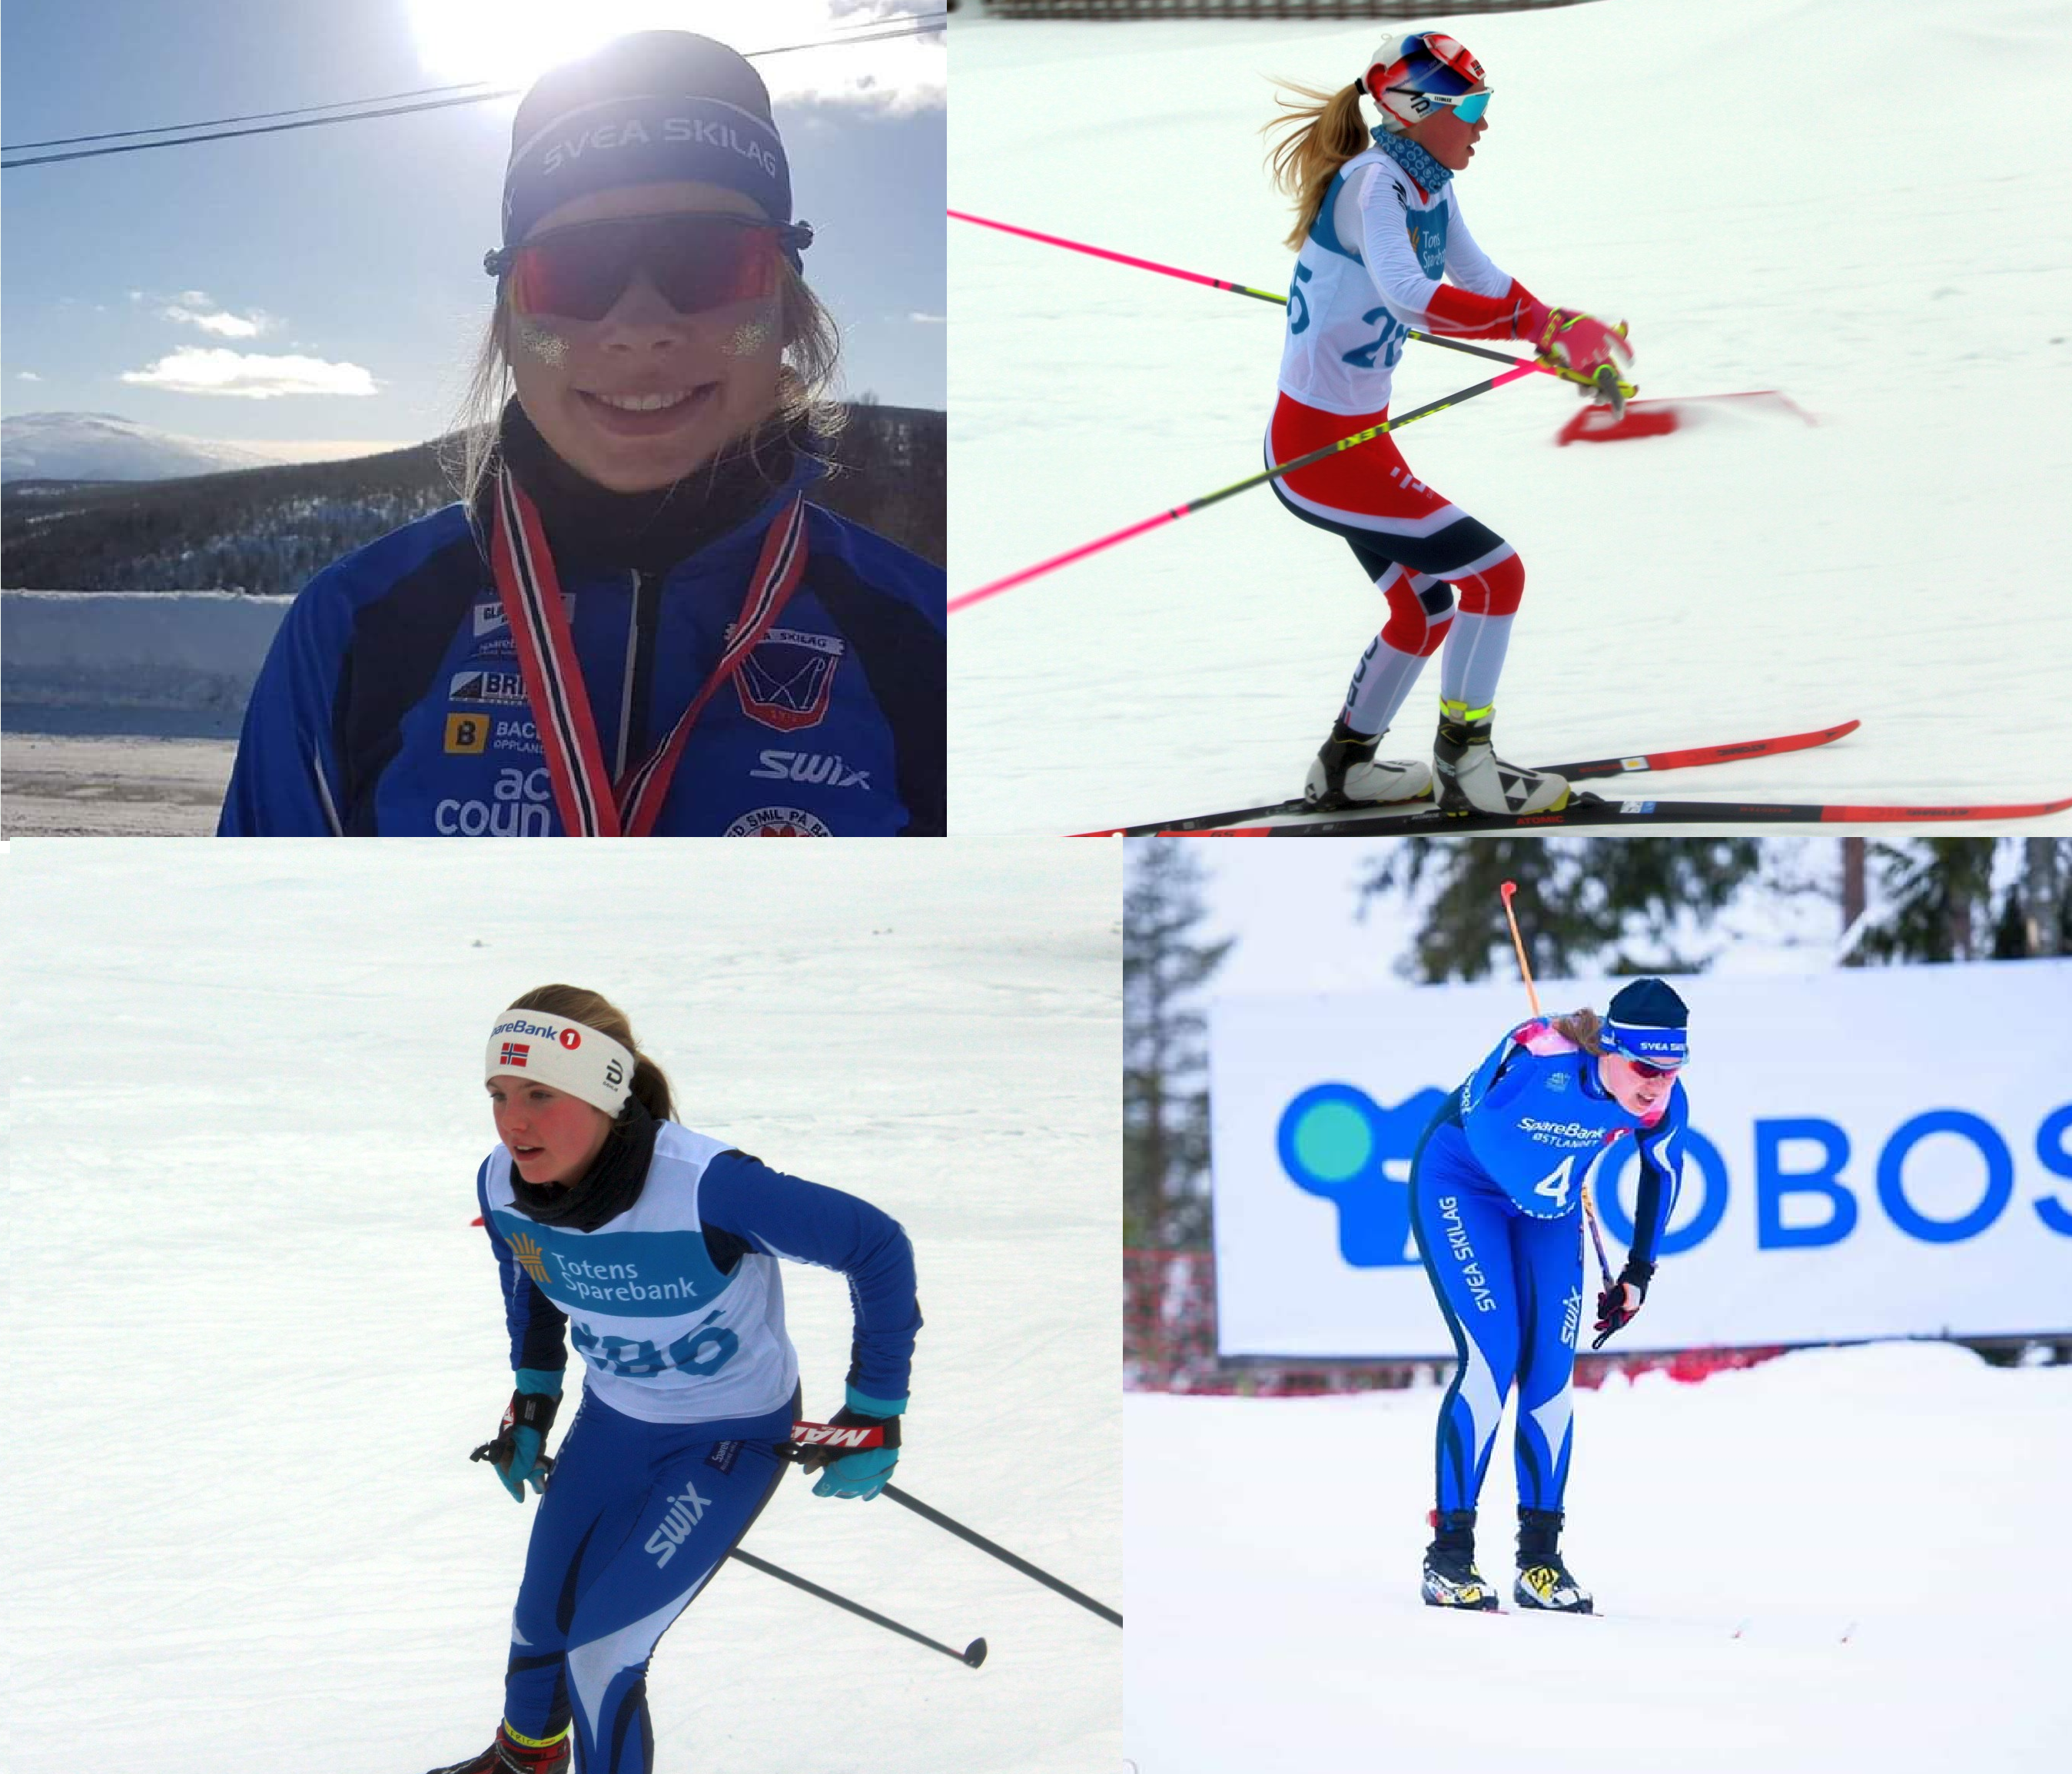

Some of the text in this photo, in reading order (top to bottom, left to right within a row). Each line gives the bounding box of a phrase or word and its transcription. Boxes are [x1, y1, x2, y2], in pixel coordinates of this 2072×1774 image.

[543, 118, 775, 178] SVEA SKILAG
[486, 673, 526, 696] BRI
[456, 721, 476, 746] B
[496, 721, 540, 740] BAC
[745, 809, 784, 826] SMIL
[1516, 816, 1565, 825] ATOMIC
[490, 1019, 559, 1041] pareBank
[1534, 1155, 1575, 1207] 4
[551, 1252, 639, 1280] Totens
[1438, 1196, 1496, 1313] SVEA SKILAG
[560, 1271, 699, 1301] Sparebank
